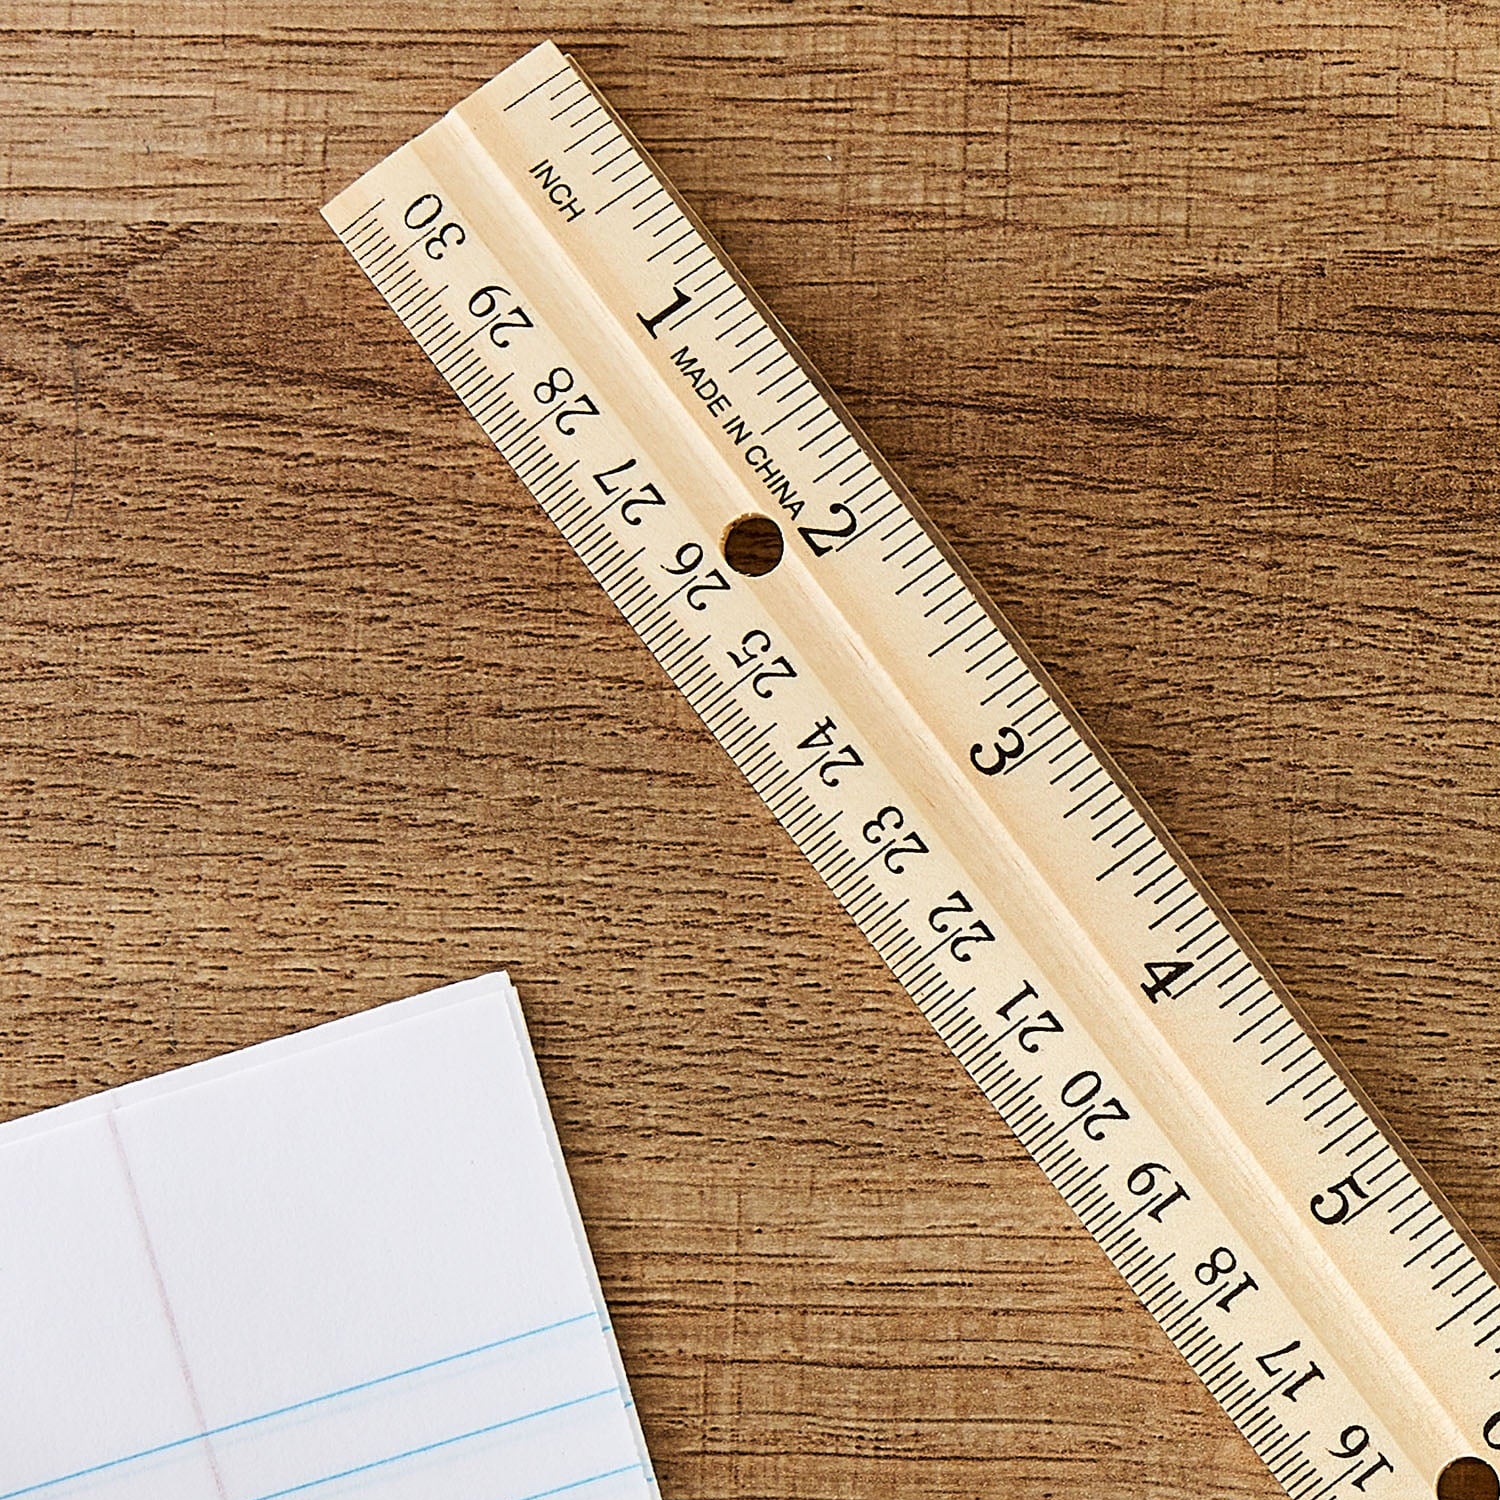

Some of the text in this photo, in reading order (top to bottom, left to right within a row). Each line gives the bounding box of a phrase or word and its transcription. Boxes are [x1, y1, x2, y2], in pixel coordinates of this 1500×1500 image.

[529, 159, 585, 222] INCH
[405, 194, 465, 259] 30
[469, 286, 533, 348] 29
[637, 287, 691, 339] 1
[534, 368, 599, 435] 28
[670, 346, 806, 521] MADE IN CHINA
[593, 459, 666, 525] 27
[798, 503, 857, 558] 2
[661, 542, 731, 611] 26
[727, 630, 797, 698] 25
[797, 716, 864, 787] 24
[970, 727, 1024, 776] 3
[863, 806, 929, 874] 23
[929, 891, 995, 962] 22
[1141, 962, 1194, 1004] 4
[996, 980, 1064, 1053] 21
[1062, 1071, 1130, 1140] 20
[1128, 1163, 1190, 1223] 19
[1310, 1175, 1370, 1226] 5
[1195, 1247, 1258, 1312] 18
[1256, 1341, 1325, 1402] 17
[1326, 1425, 1393, 1492] 16
